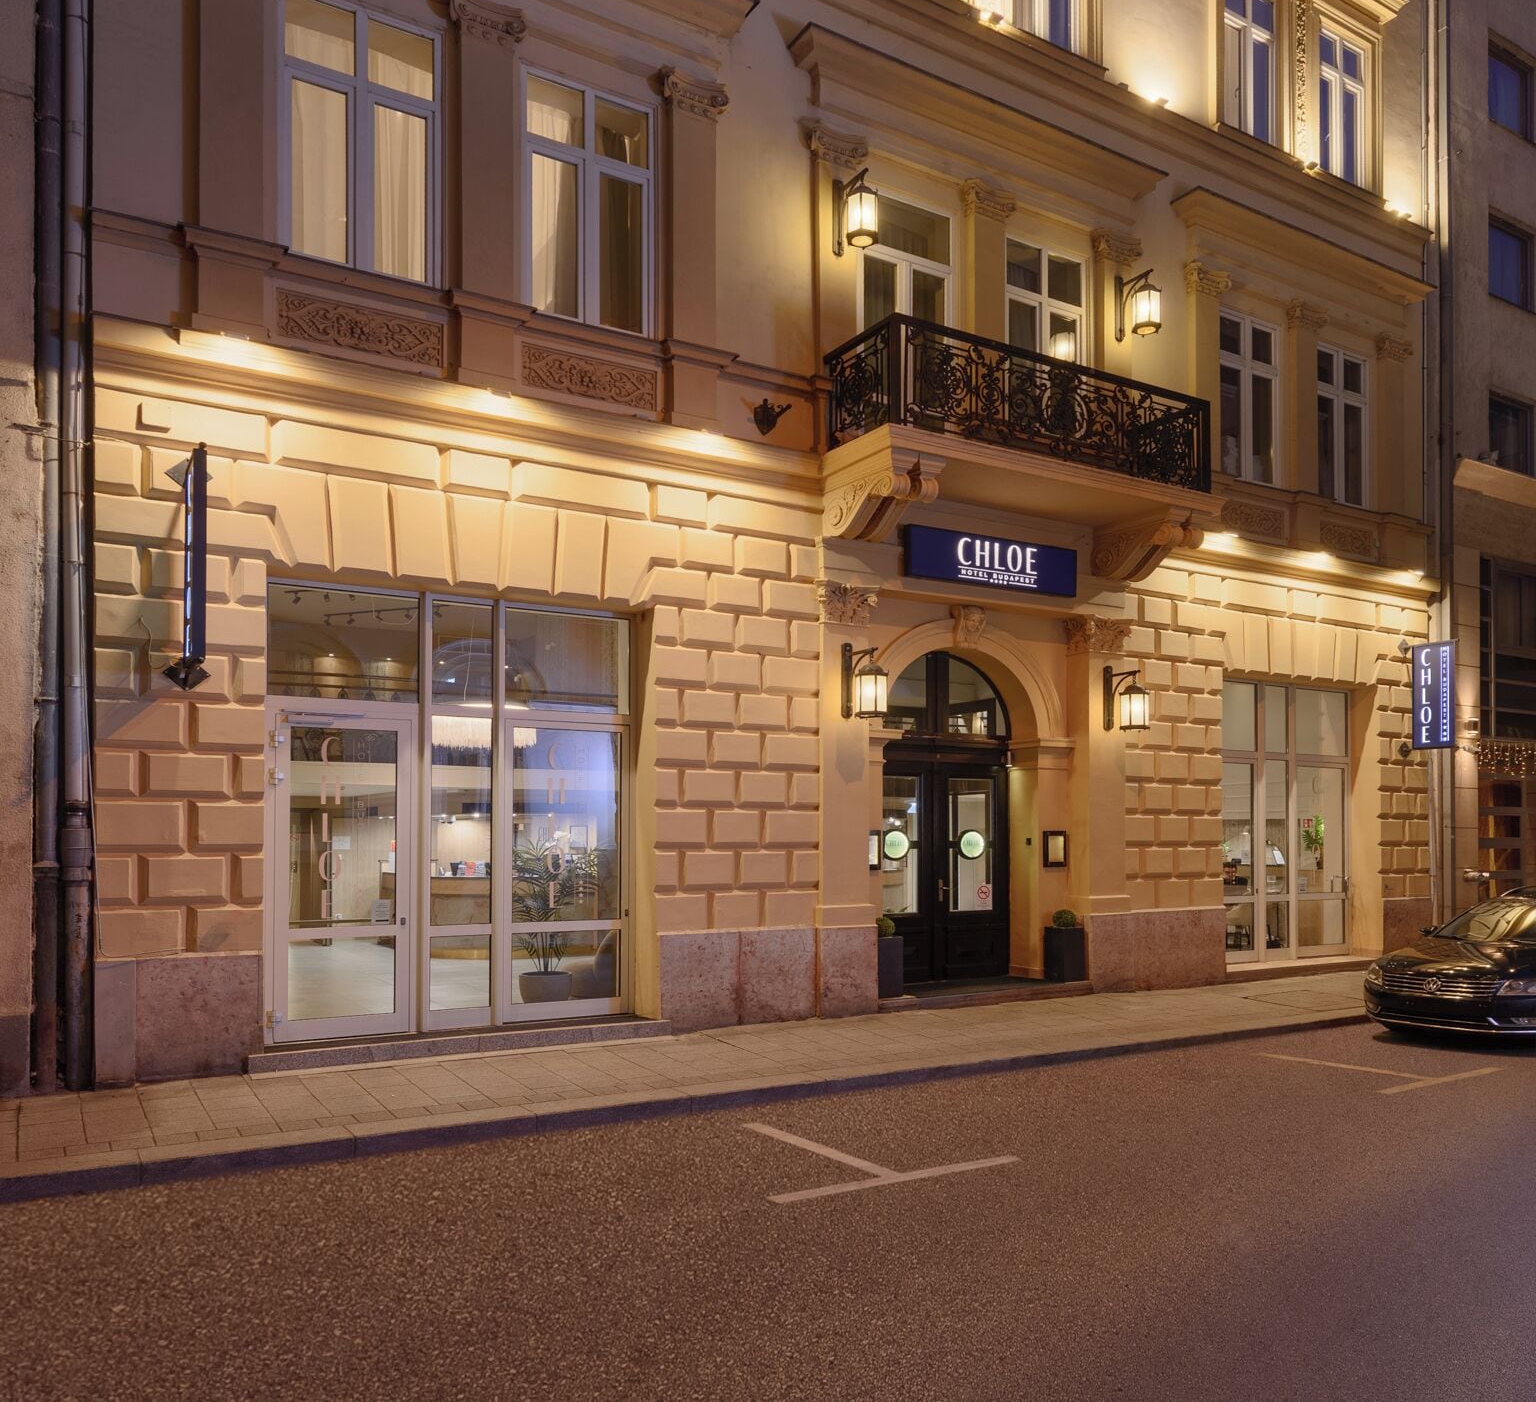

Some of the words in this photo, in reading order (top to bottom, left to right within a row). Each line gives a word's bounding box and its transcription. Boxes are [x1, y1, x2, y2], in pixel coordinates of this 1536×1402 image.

[957, 537, 1037, 575] CHLOE
[961, 568, 988, 578] HOTEL
[992, 573, 1035, 584] BUDAPEST
[1420, 648, 1432, 743] CHLOE
